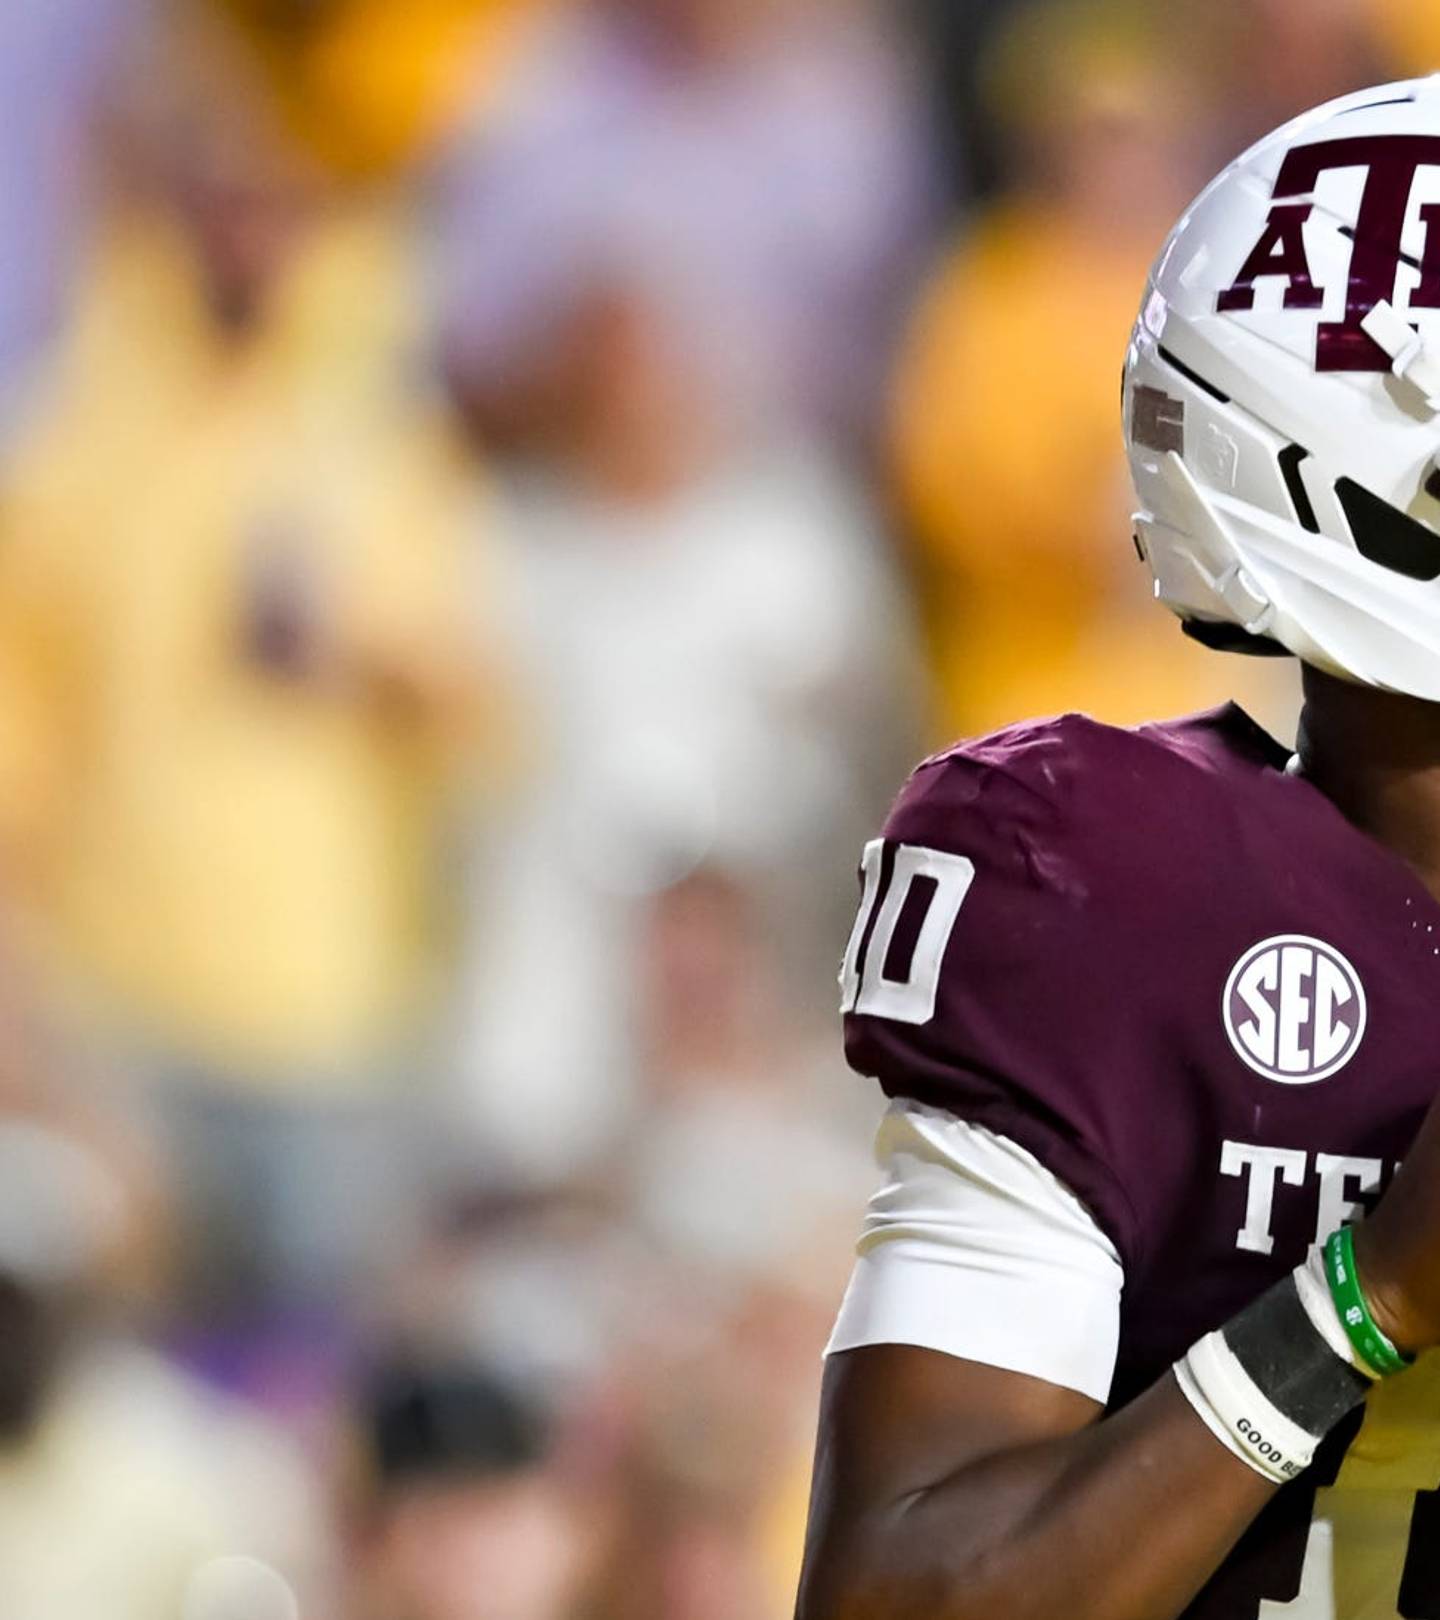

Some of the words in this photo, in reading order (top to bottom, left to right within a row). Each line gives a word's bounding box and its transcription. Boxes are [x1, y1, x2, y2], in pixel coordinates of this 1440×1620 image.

[1235, 944, 1353, 1074] SEC
[1219, 1139, 1402, 1255] TE
[1236, 1417, 1283, 1464] GOOD
